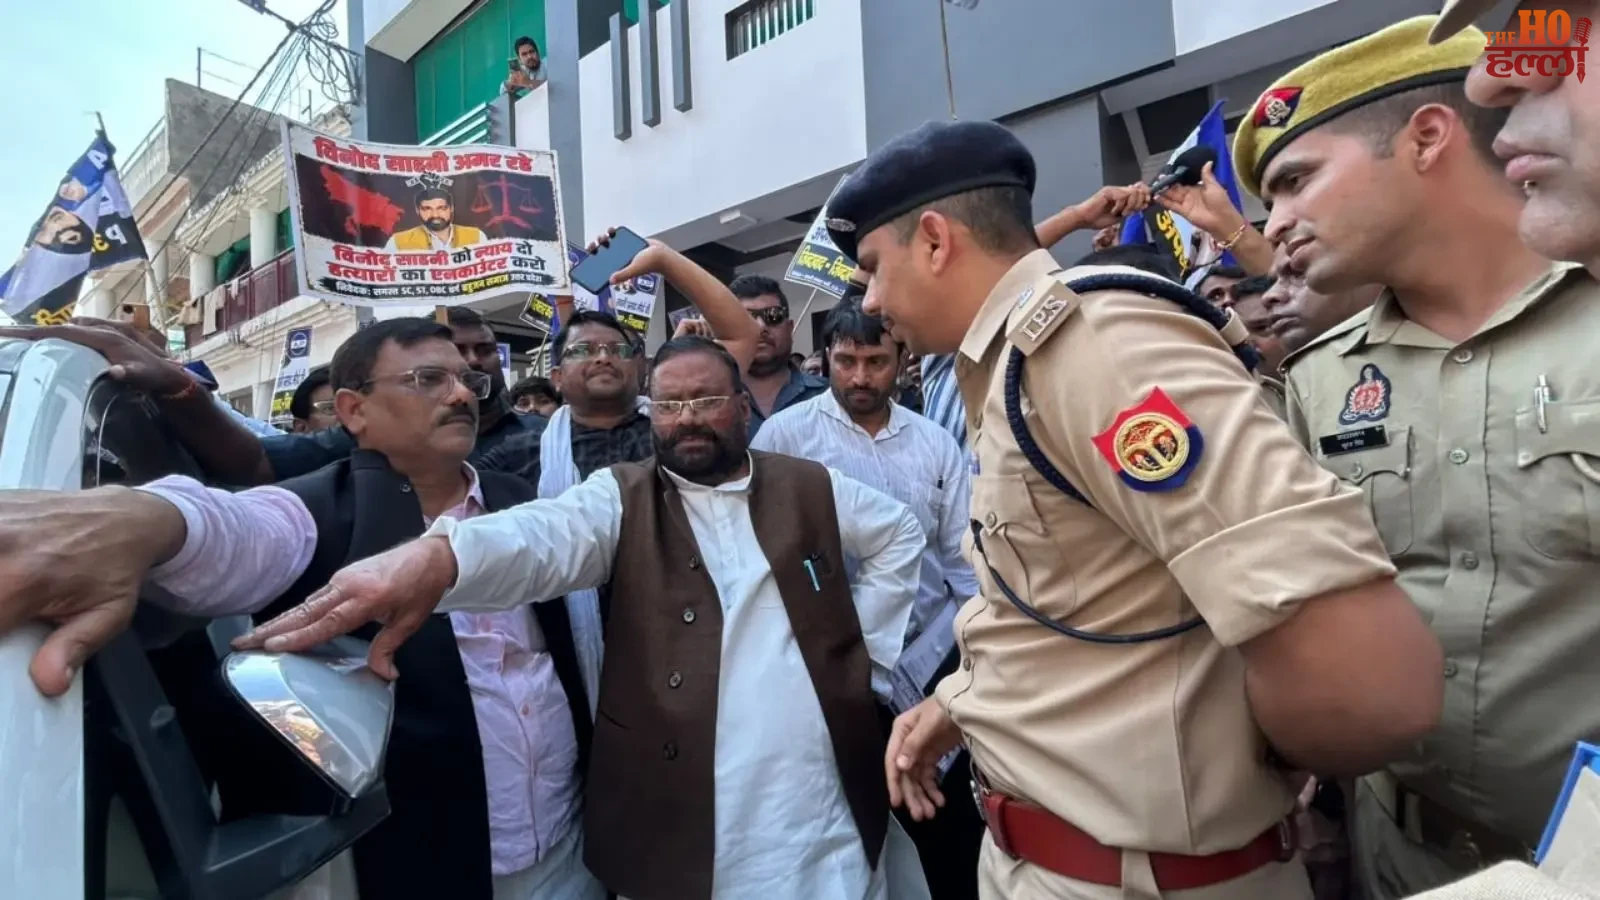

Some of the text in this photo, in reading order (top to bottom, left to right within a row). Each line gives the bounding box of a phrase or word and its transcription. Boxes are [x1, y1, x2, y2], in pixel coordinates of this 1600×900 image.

[315, 136, 533, 173] विनोद साहनी अमर रहे
[328, 254, 546, 282] हत्यारों का एनकाउंटर करो
[333, 240, 532, 267] विनोद साहनी को न्याय दो
[1021, 295, 1067, 342] IPS
